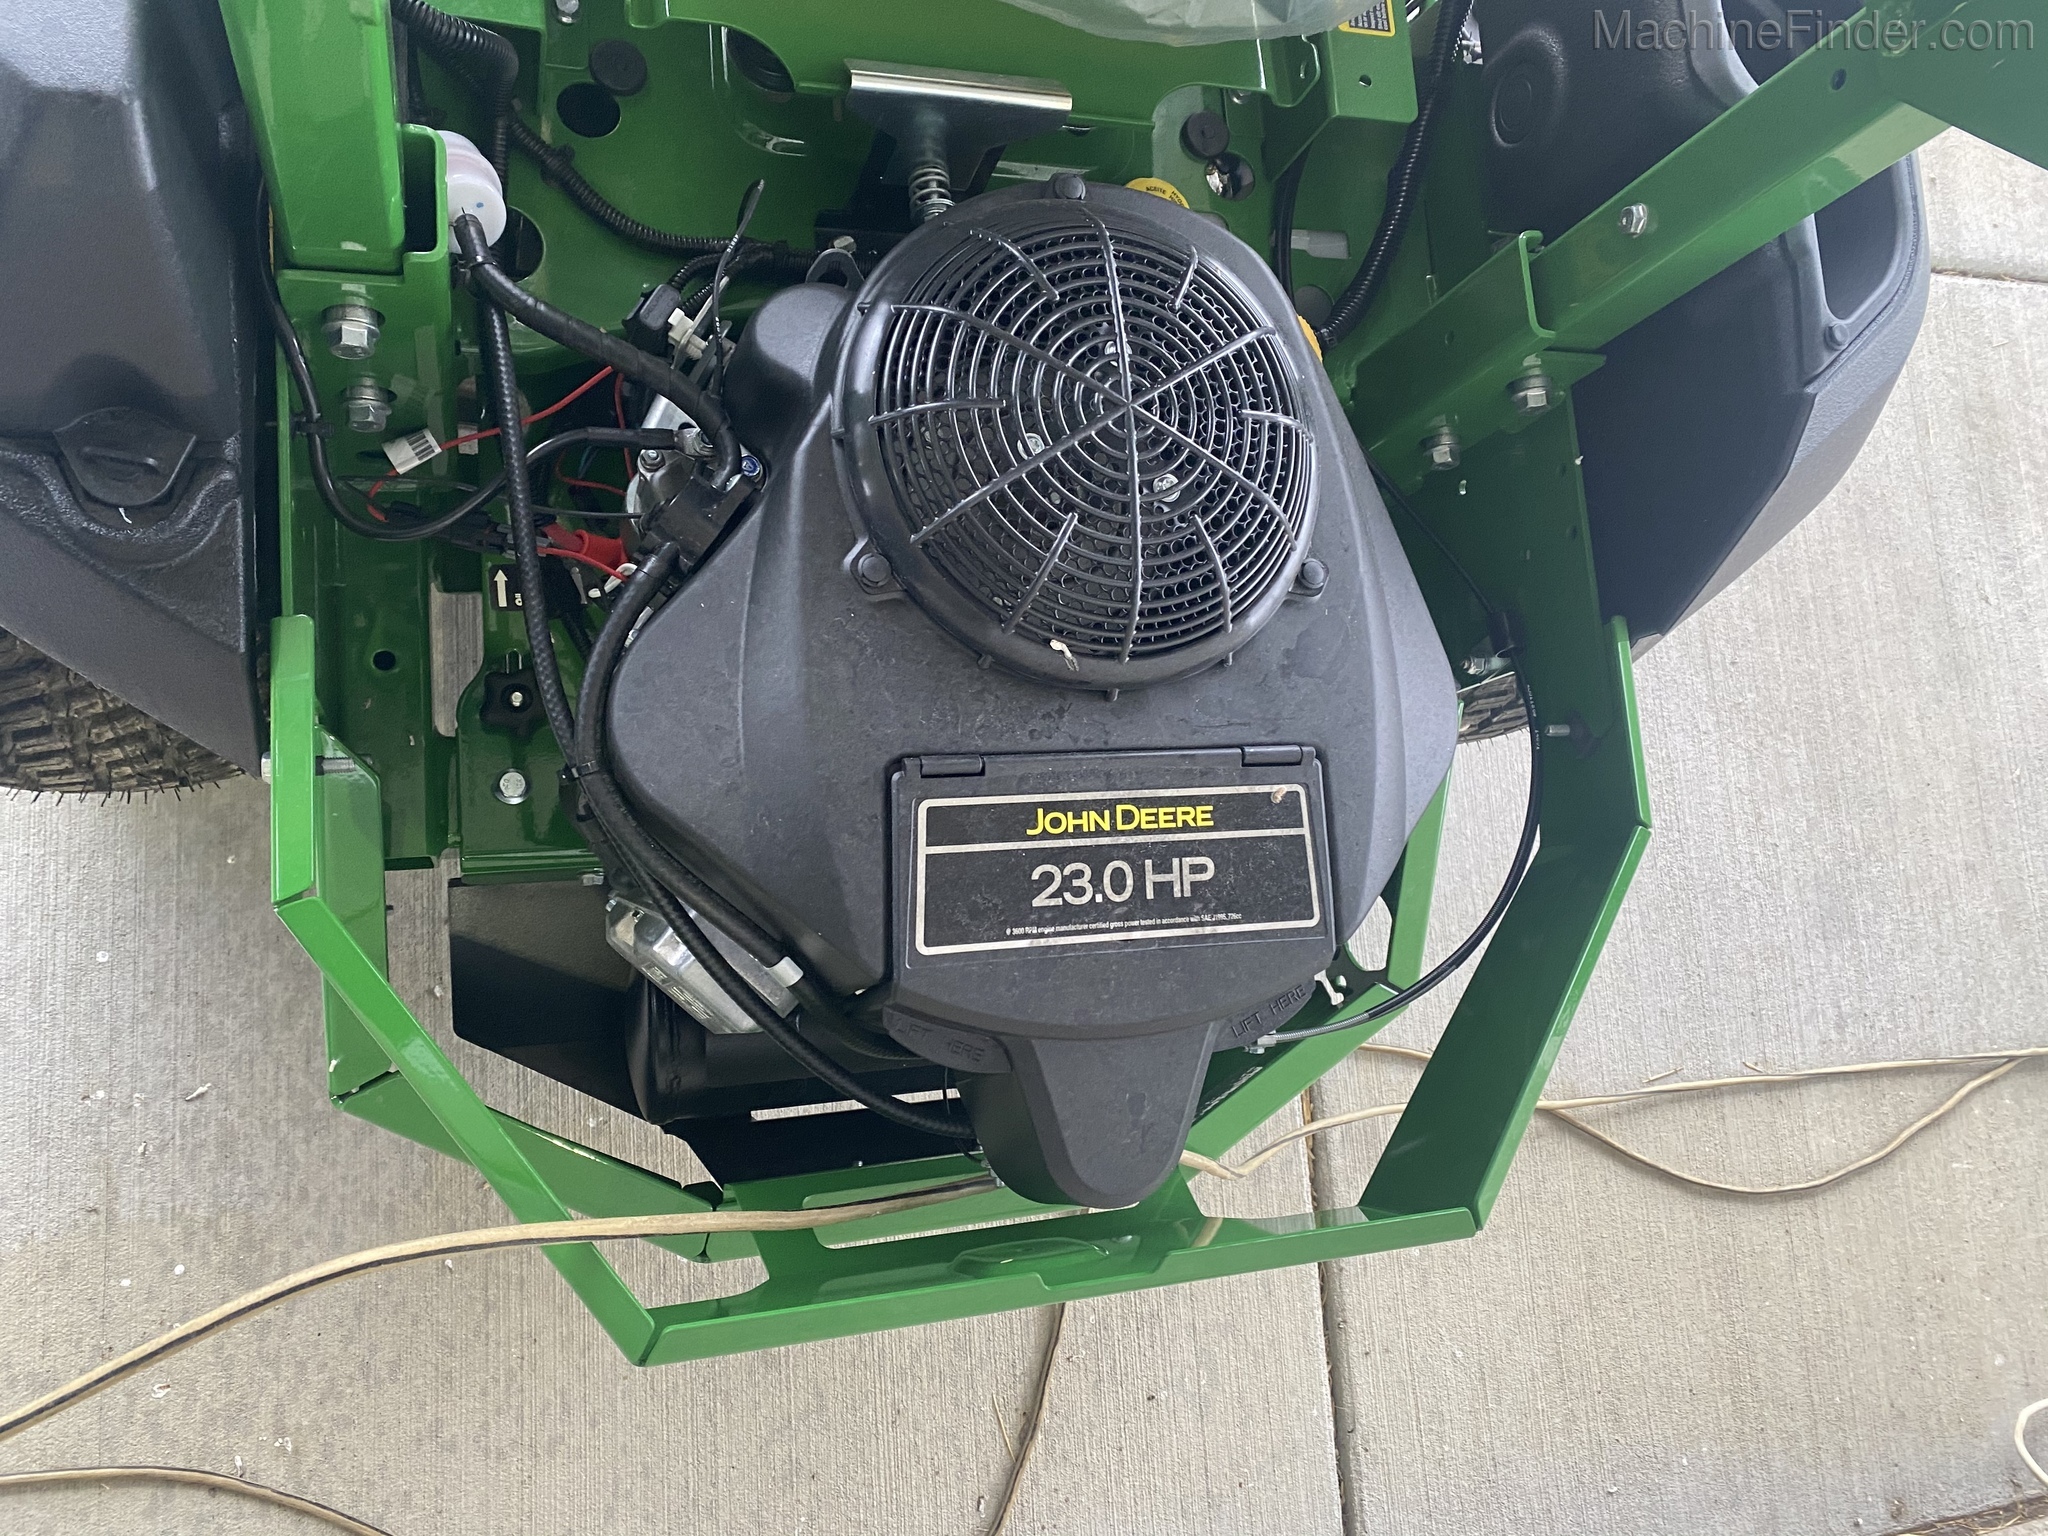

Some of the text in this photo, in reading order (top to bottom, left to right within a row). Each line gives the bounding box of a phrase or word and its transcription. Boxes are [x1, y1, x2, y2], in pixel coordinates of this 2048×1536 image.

[1146, 186, 1167, 195] ACEITE
[1026, 804, 1215, 836] JOHN DEERE
[1030, 856, 1216, 907] 23.0 HP
[1025, 926, 1037, 934] RPM
[1038, 926, 1055, 935] engine
[1056, 923, 1088, 931] manufacturer
[1089, 921, 1109, 929] certified
[1110, 921, 1124, 930] gross
[1125, 919, 1139, 928] power
[1140, 918, 1155, 926] tested
[1156, 917, 1161, 925] in
[1162, 916, 1190, 925] accordance
[1231, 985, 1307, 1038] LIFT HERE
